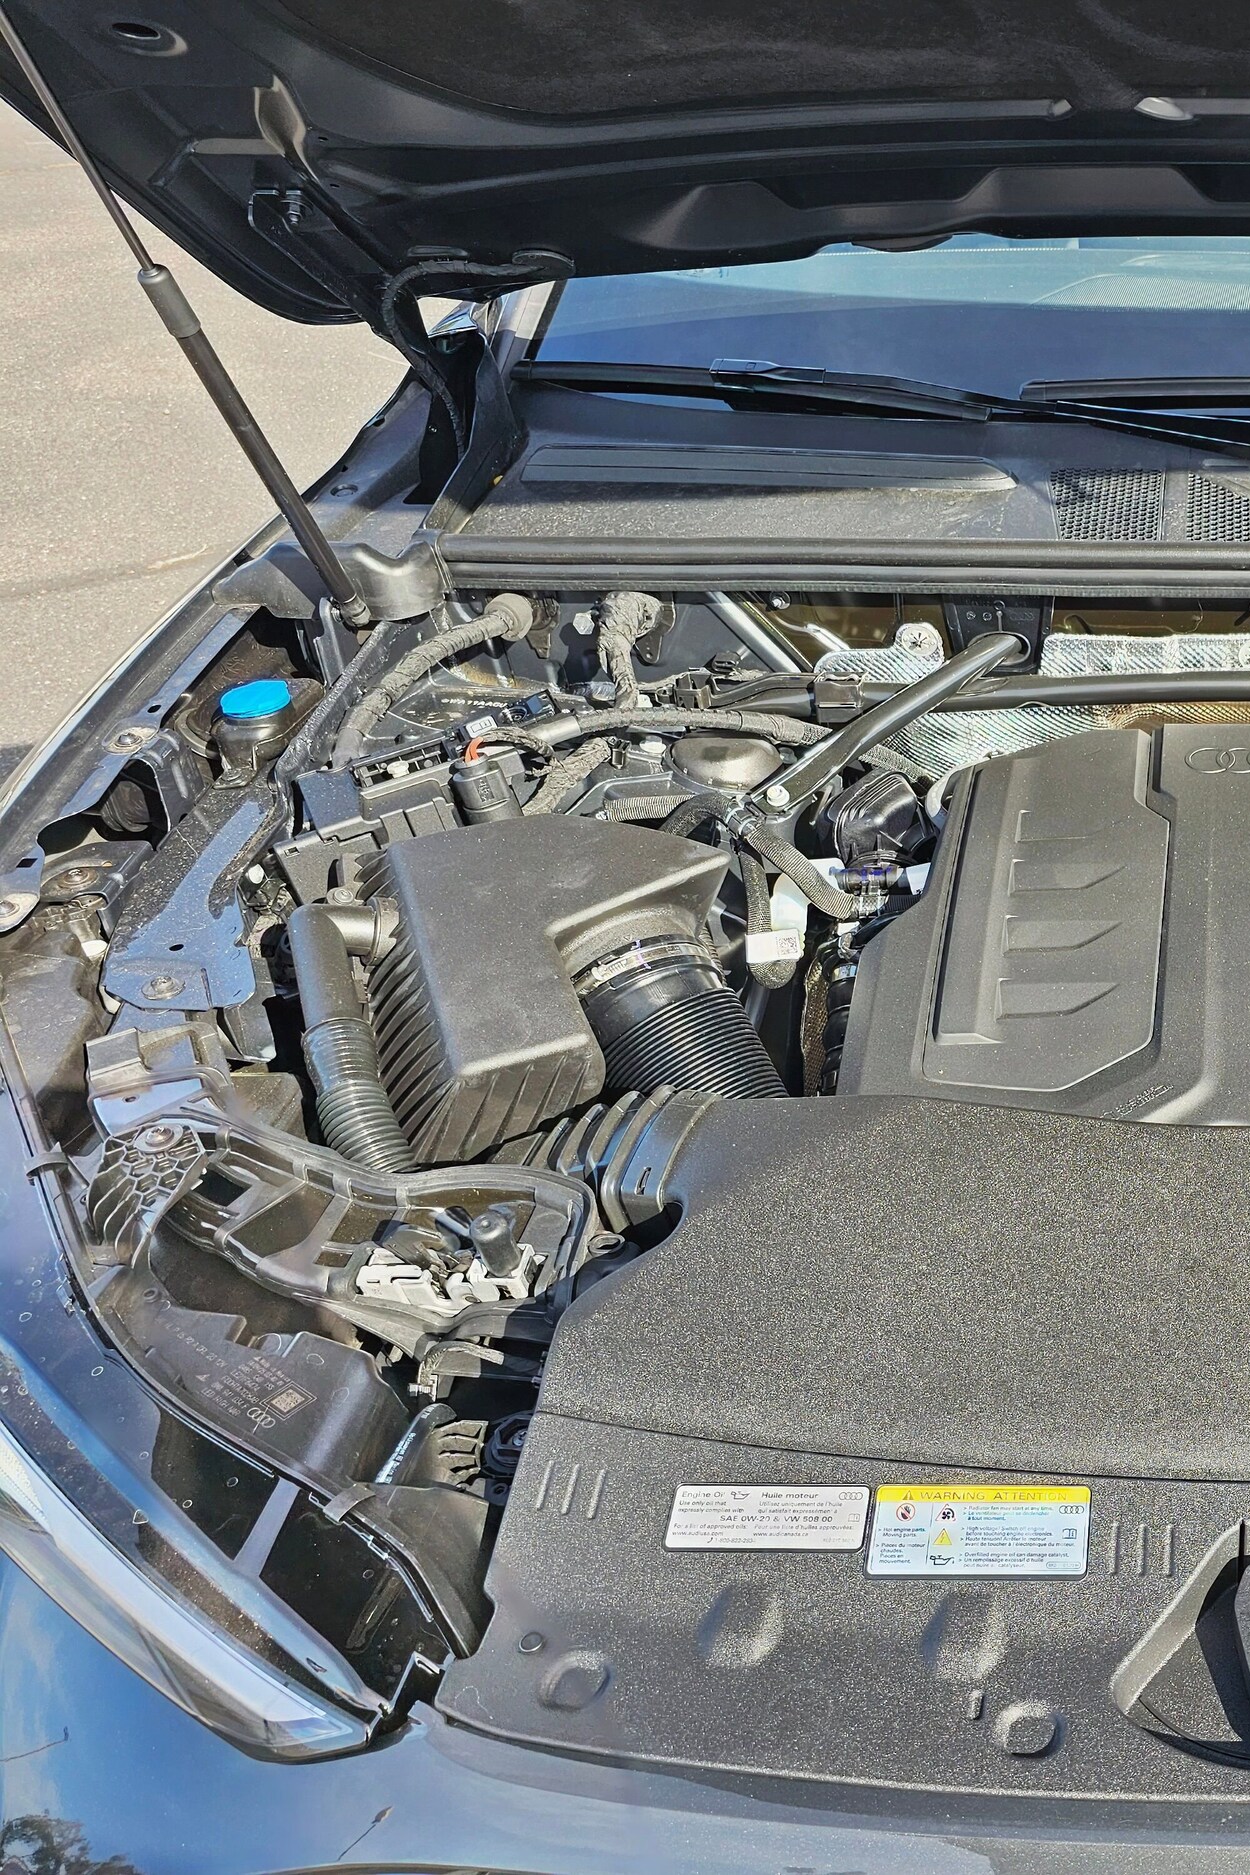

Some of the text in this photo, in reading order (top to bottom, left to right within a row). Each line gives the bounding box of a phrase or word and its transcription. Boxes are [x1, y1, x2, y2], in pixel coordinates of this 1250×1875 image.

[681, 1491, 711, 1499] Engine
[761, 1491, 783, 1499] Huile
[920, 1491, 1067, 1501] WARNING ATTENTION
[803, 1515, 819, 1523] 508
